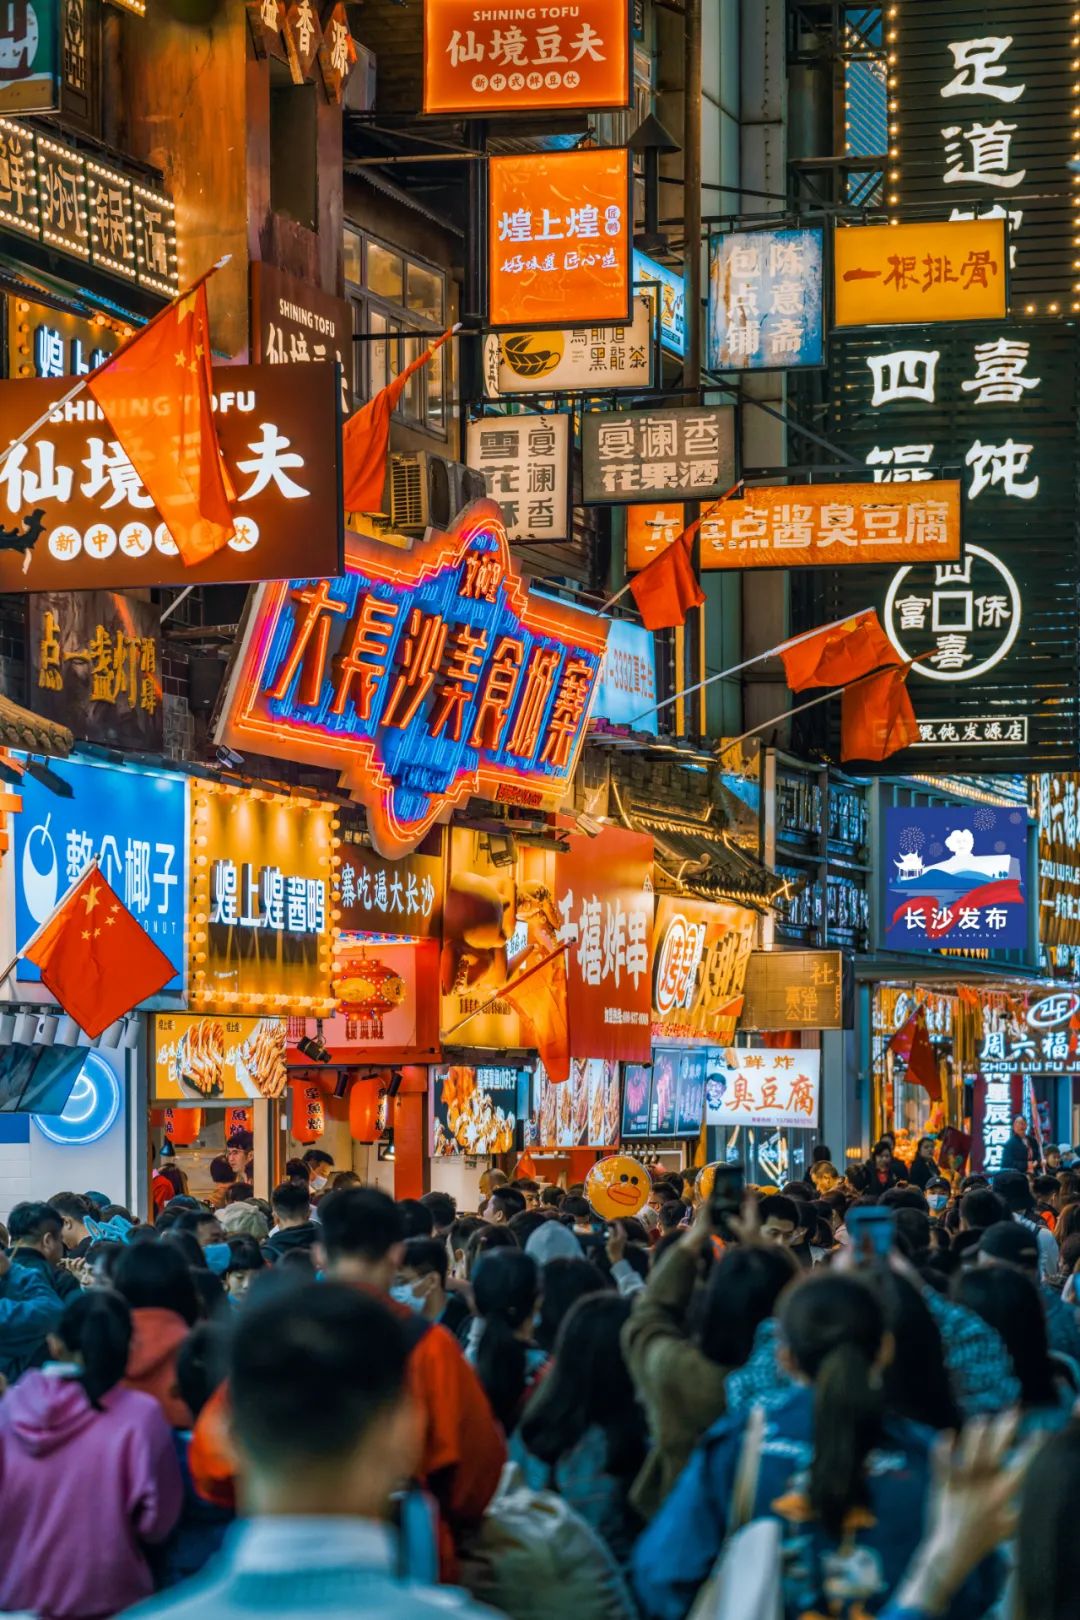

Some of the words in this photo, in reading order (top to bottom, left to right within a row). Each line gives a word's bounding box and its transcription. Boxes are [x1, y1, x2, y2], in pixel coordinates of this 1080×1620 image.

[472, 8, 536, 21] SHINING
[540, 6, 580, 18] TOFU
[446, 22, 607, 68] 仙境豆夫
[472, 70, 581, 93] 新中式鲜豆饮
[498, 203, 600, 242] 煌上煌
[842, 250, 998, 293] 一根排骨
[279, 298, 314, 329] SHINING
[313, 314, 336, 338] TOFU
[589, 345, 648, 372] 黑龍茶
[866, 337, 1041, 406] 四喜
[597, 414, 720, 462] 宴澜香
[526, 425, 556, 529] 宴澜香
[600, 459, 720, 492] 花果酒
[865, 437, 1039, 499] 馄饨
[919, 722, 1024, 743] 馄饨发源店
[66, 829, 178, 914] 整个椰子
[333, 862, 436, 918] 寨吃遍大长沙
[904, 907, 1008, 930] 长沙发布
[555, 888, 648, 991] 千禧炸串
[980, 1032, 1080, 1060] 周六福
[980, 1062, 1018, 1071] ZHOU
[1020, 1062, 1042, 1071] LIU
[1045, 1062, 1064, 1071] FU
[725, 1073, 815, 1116] 臭豆腐
